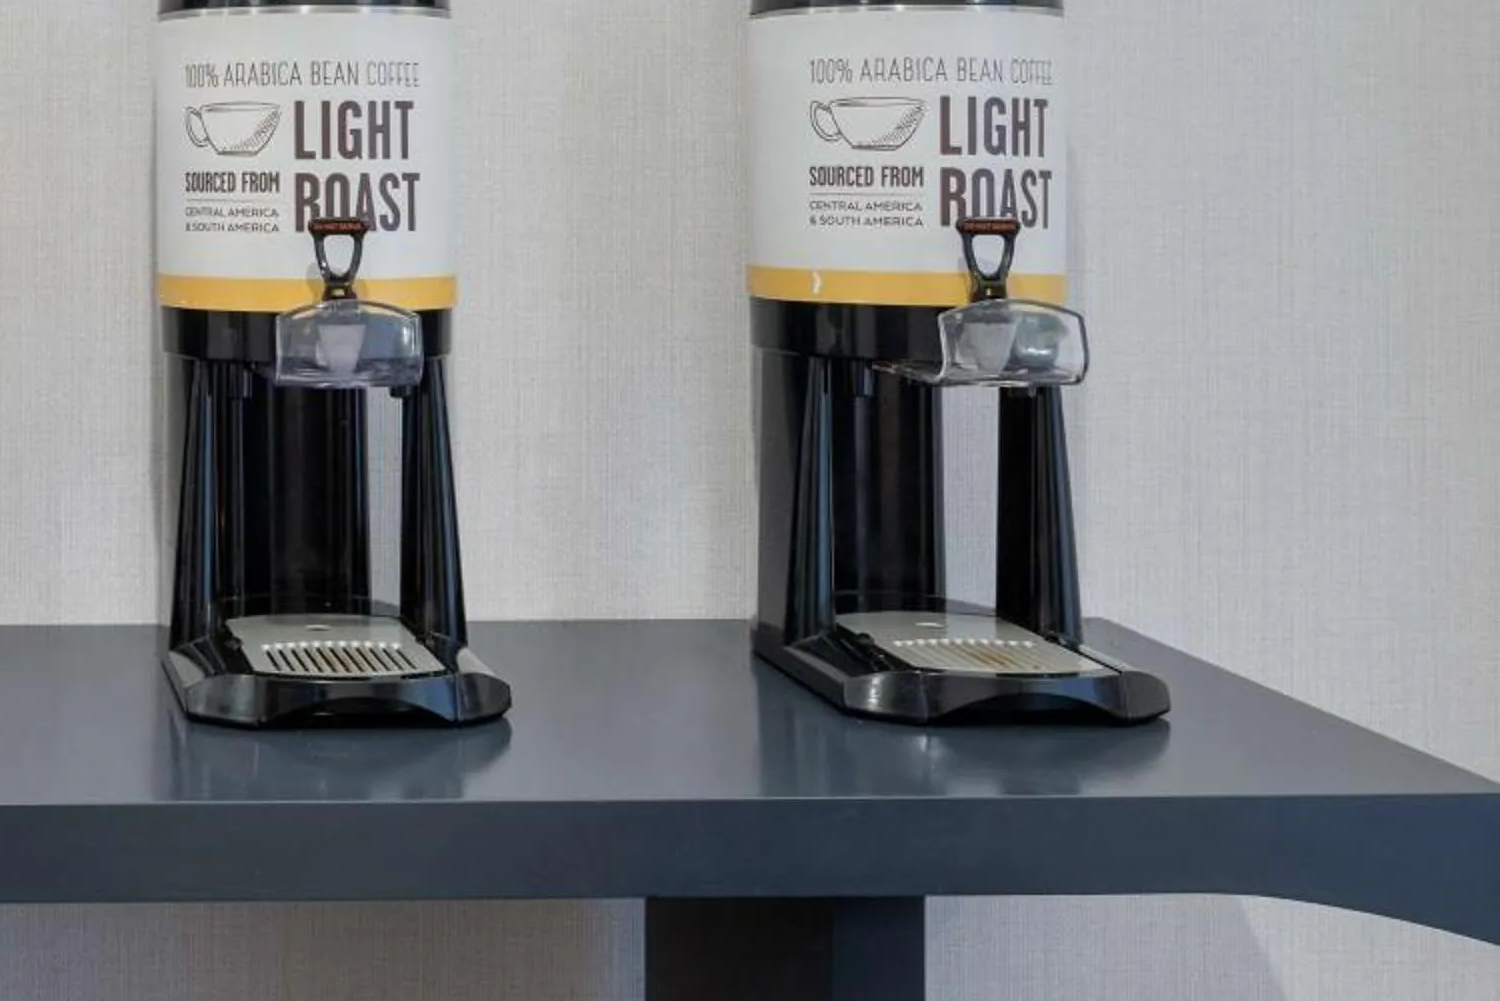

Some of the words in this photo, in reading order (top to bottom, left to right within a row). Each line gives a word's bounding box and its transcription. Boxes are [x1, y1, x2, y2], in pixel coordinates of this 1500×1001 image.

[185, 62, 219, 88] 100%
[223, 61, 302, 87] ARABICA
[311, 61, 359, 86] BEAN
[367, 61, 420, 88] COFFEE
[810, 59, 852, 84] 100%
[860, 56, 948, 83] ARABICA
[956, 57, 1004, 83] BEAN
[1011, 59, 1053, 86] COFFEE
[294, 100, 414, 160] LIGHT
[940, 95, 1049, 157] LIGHT
[185, 171, 236, 193] SOURCED
[242, 171, 280, 194] FROM
[809, 166, 874, 187] SOURCED
[881, 166, 924, 187] FROM
[295, 172, 420, 232] ROAST
[809, 200, 862, 211] CENTRAL
[865, 201, 923, 212] AMERICA
[940, 167, 1053, 229] ROAST
[185, 206, 225, 218] CENTRAL
[228, 206, 279, 218] AMERICA
[819, 215, 861, 226] SOUTH
[864, 216, 923, 227] AMERICA
[227, 222, 280, 232] AMERICA
